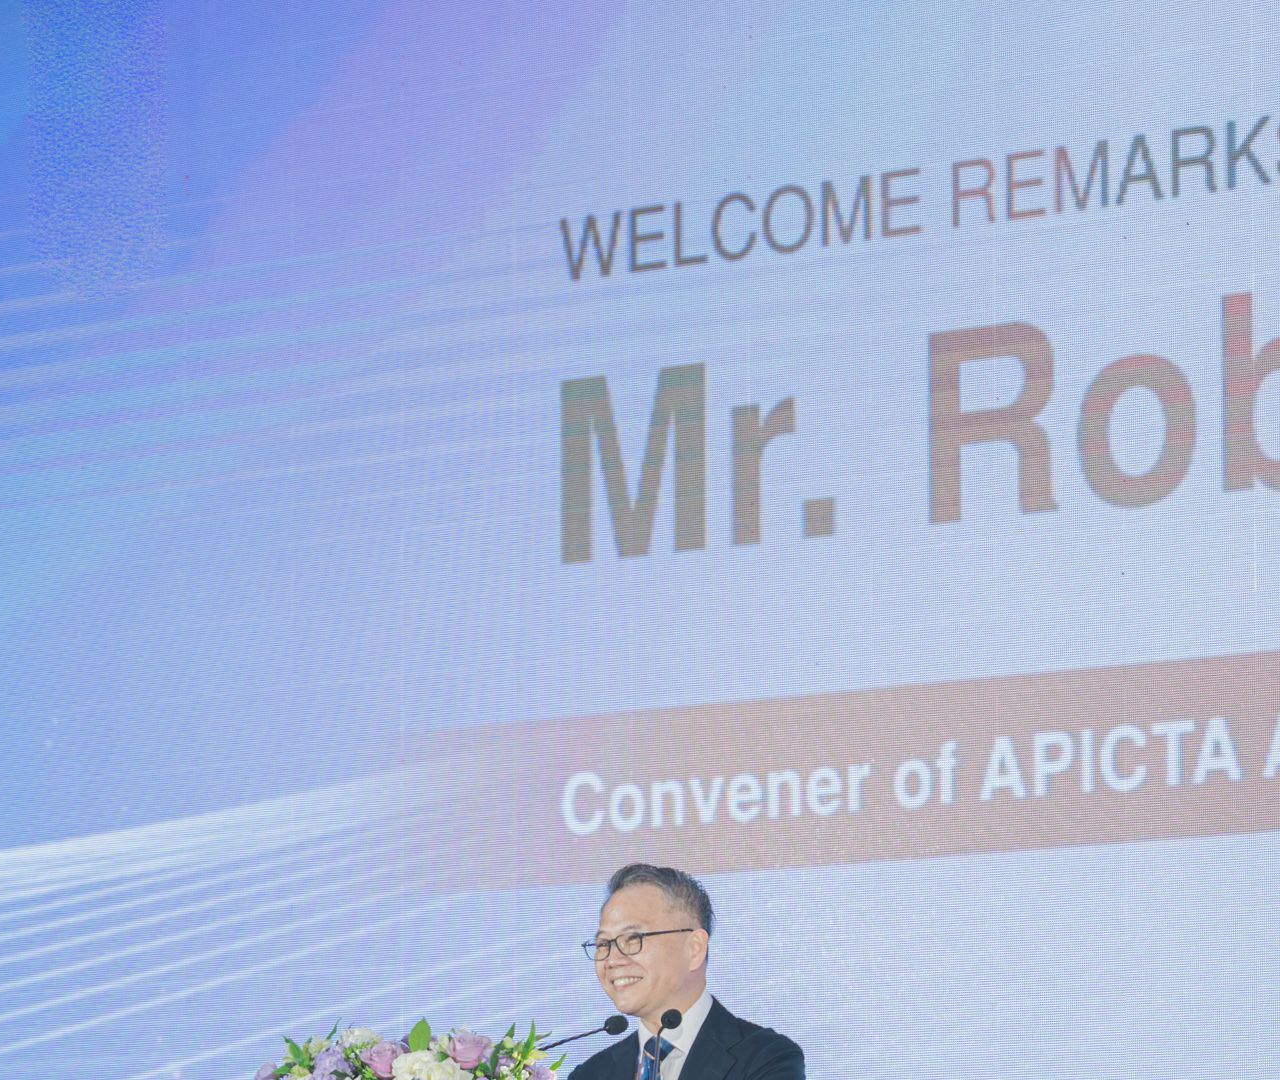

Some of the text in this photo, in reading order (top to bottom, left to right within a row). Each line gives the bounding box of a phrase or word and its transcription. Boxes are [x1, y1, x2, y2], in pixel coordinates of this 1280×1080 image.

[560, 167, 922, 281] WELCOME
[560, 362, 836, 565] Mr.
[561, 771, 873, 836] Convener
[893, 740, 959, 809] of
[979, 716, 1243, 801] APICTA
